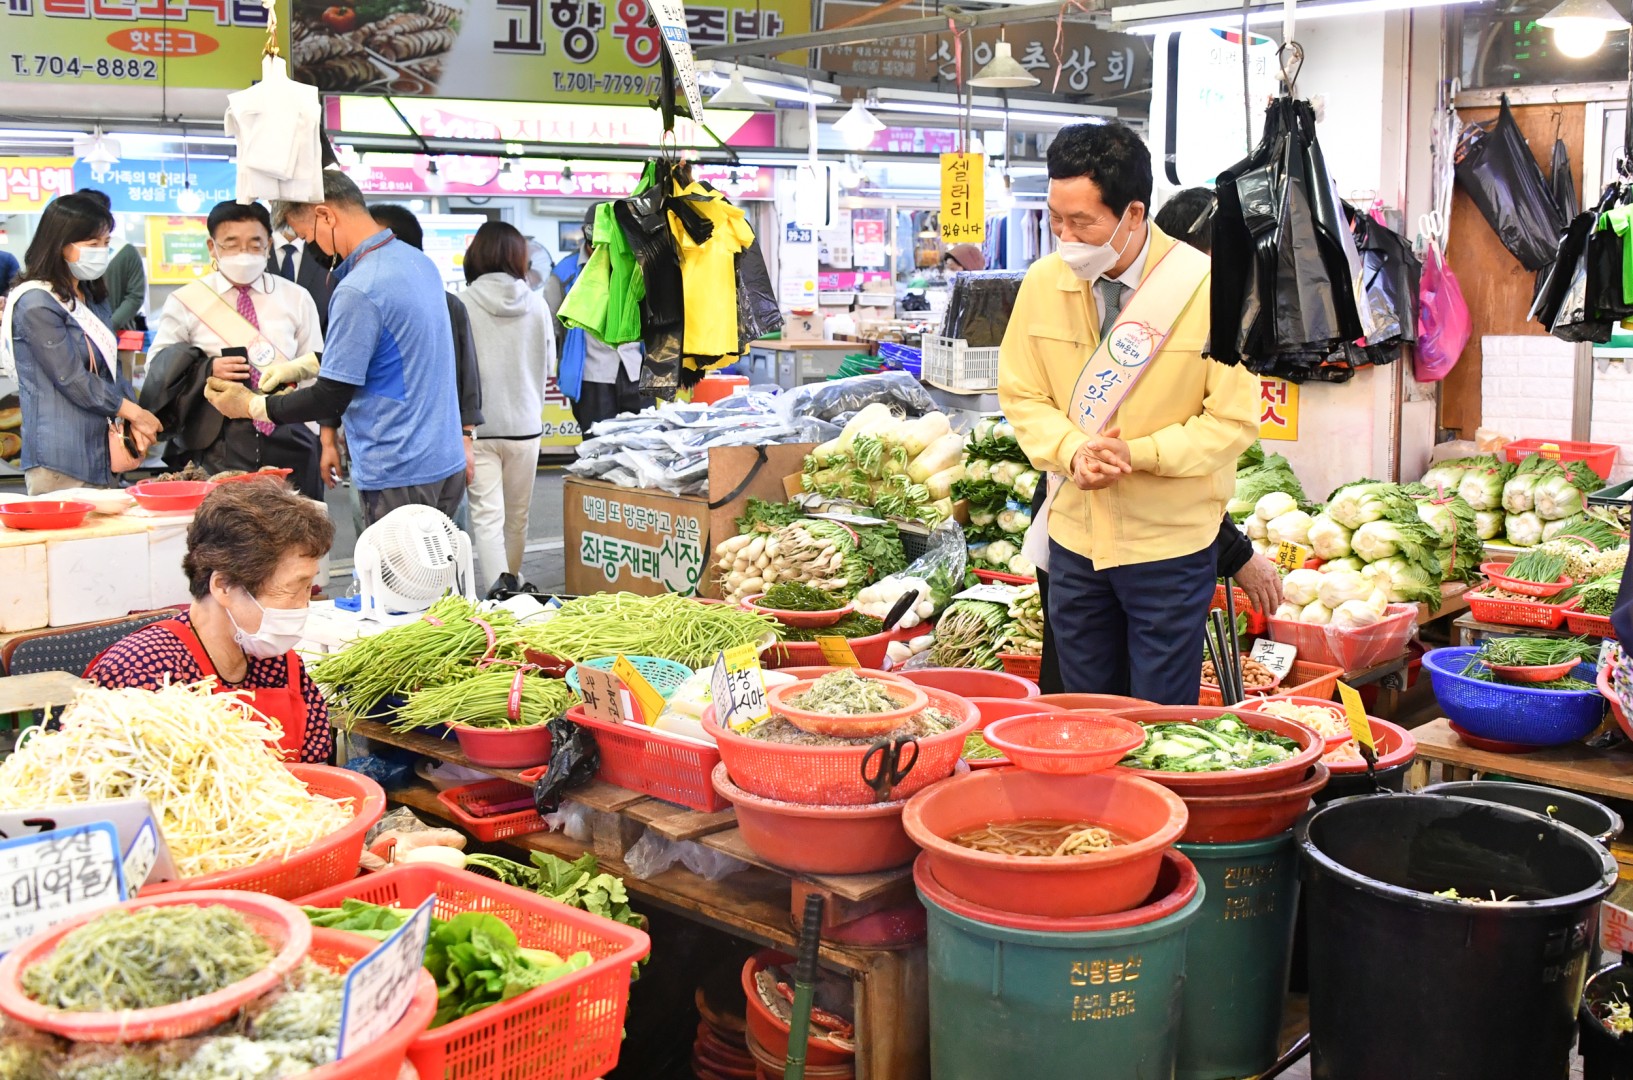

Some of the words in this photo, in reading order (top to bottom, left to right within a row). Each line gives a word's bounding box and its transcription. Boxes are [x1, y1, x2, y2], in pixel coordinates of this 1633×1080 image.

[130, 31, 197, 53] 핫도그
[107, 170, 145, 184] 가족의
[128, 188, 166, 202] 정성을
[947, 160, 971, 219] 셀러리
[787, 231, 812, 242] 99-26
[942, 222, 982, 240] 있습니다
[1115, 339, 1140, 360] 해운대
[583, 496, 606, 520] 내일
[609, 502, 621, 521] 또
[624, 506, 671, 532] 방문하고
[675, 518, 699, 542] 싶은
[582, 535, 701, 584] 좌동재래시장
